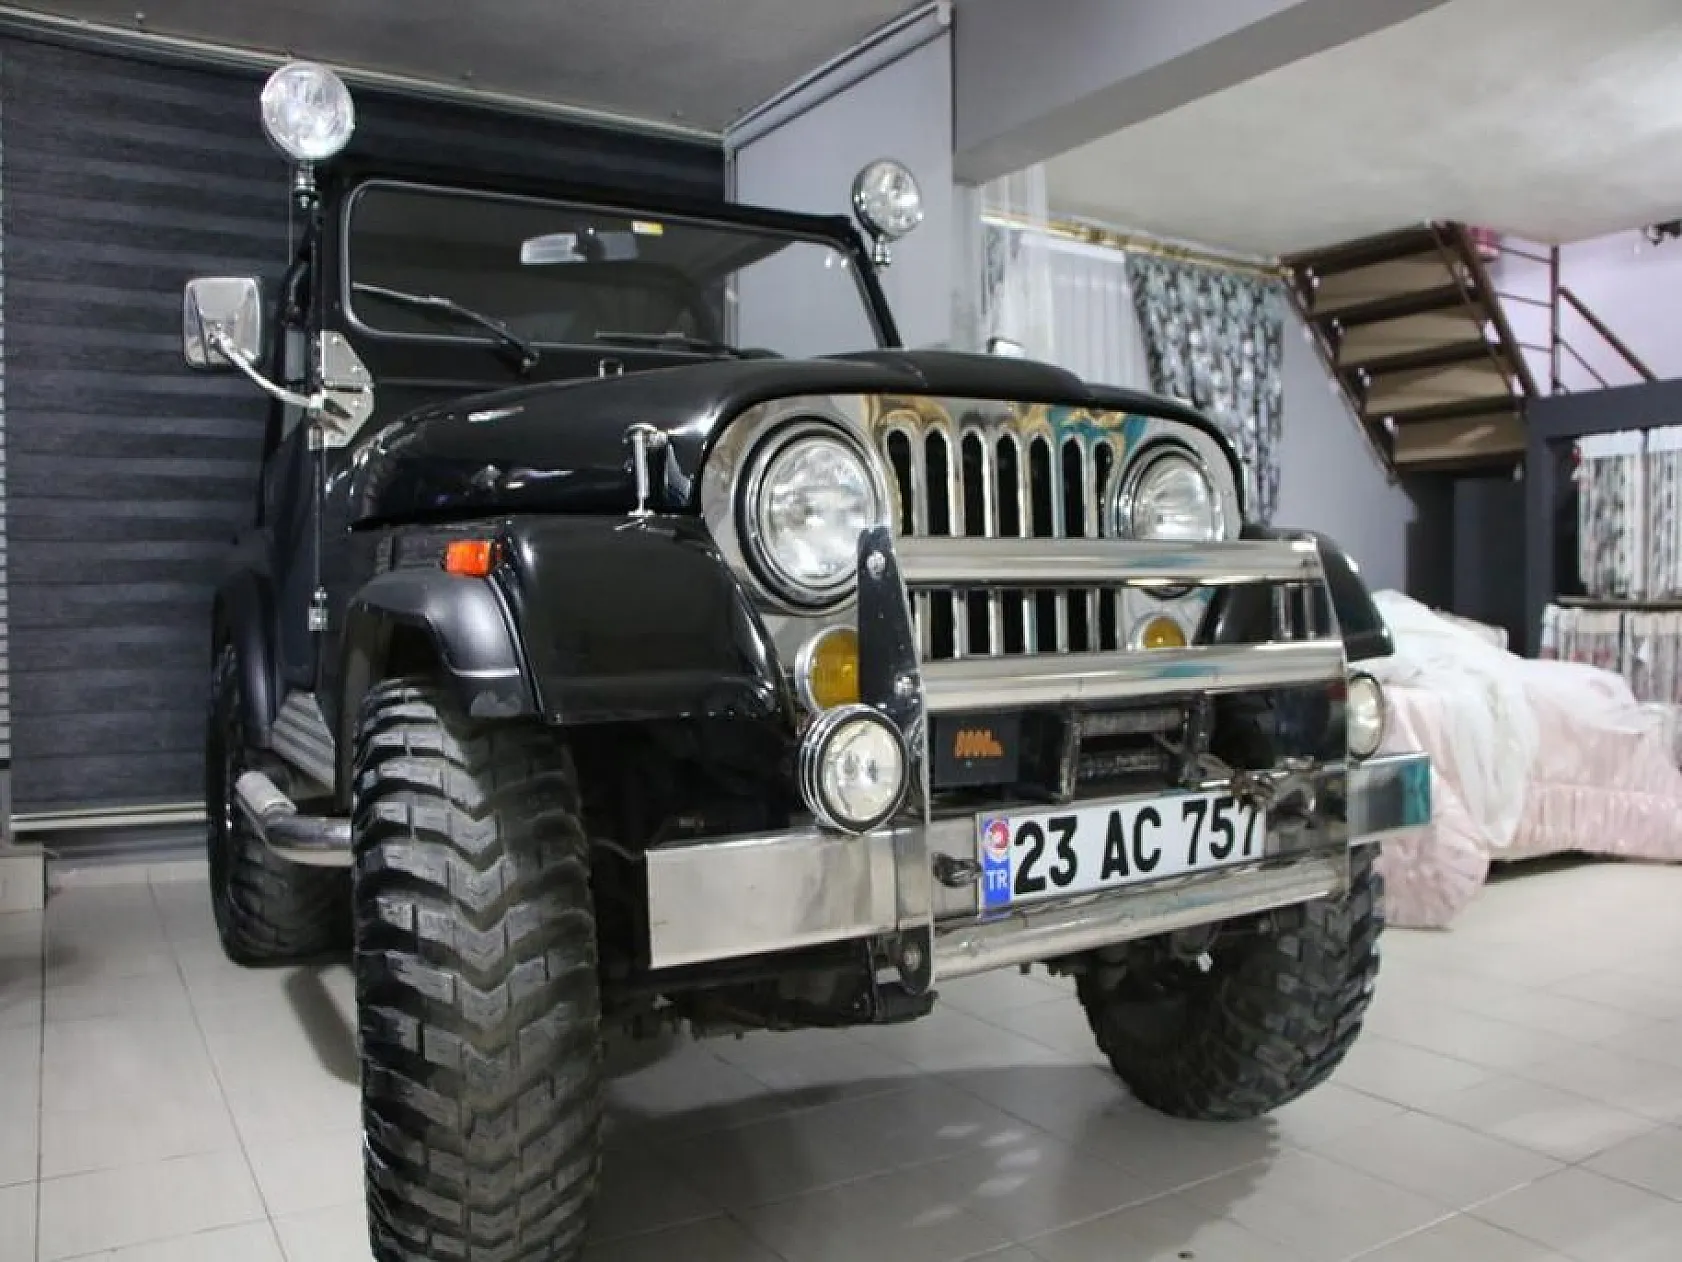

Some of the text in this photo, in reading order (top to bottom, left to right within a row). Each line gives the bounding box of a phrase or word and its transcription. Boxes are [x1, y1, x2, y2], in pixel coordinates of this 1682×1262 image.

[1014, 795, 1258, 894] 23 AC 757
[986, 869, 1008, 892] TR
